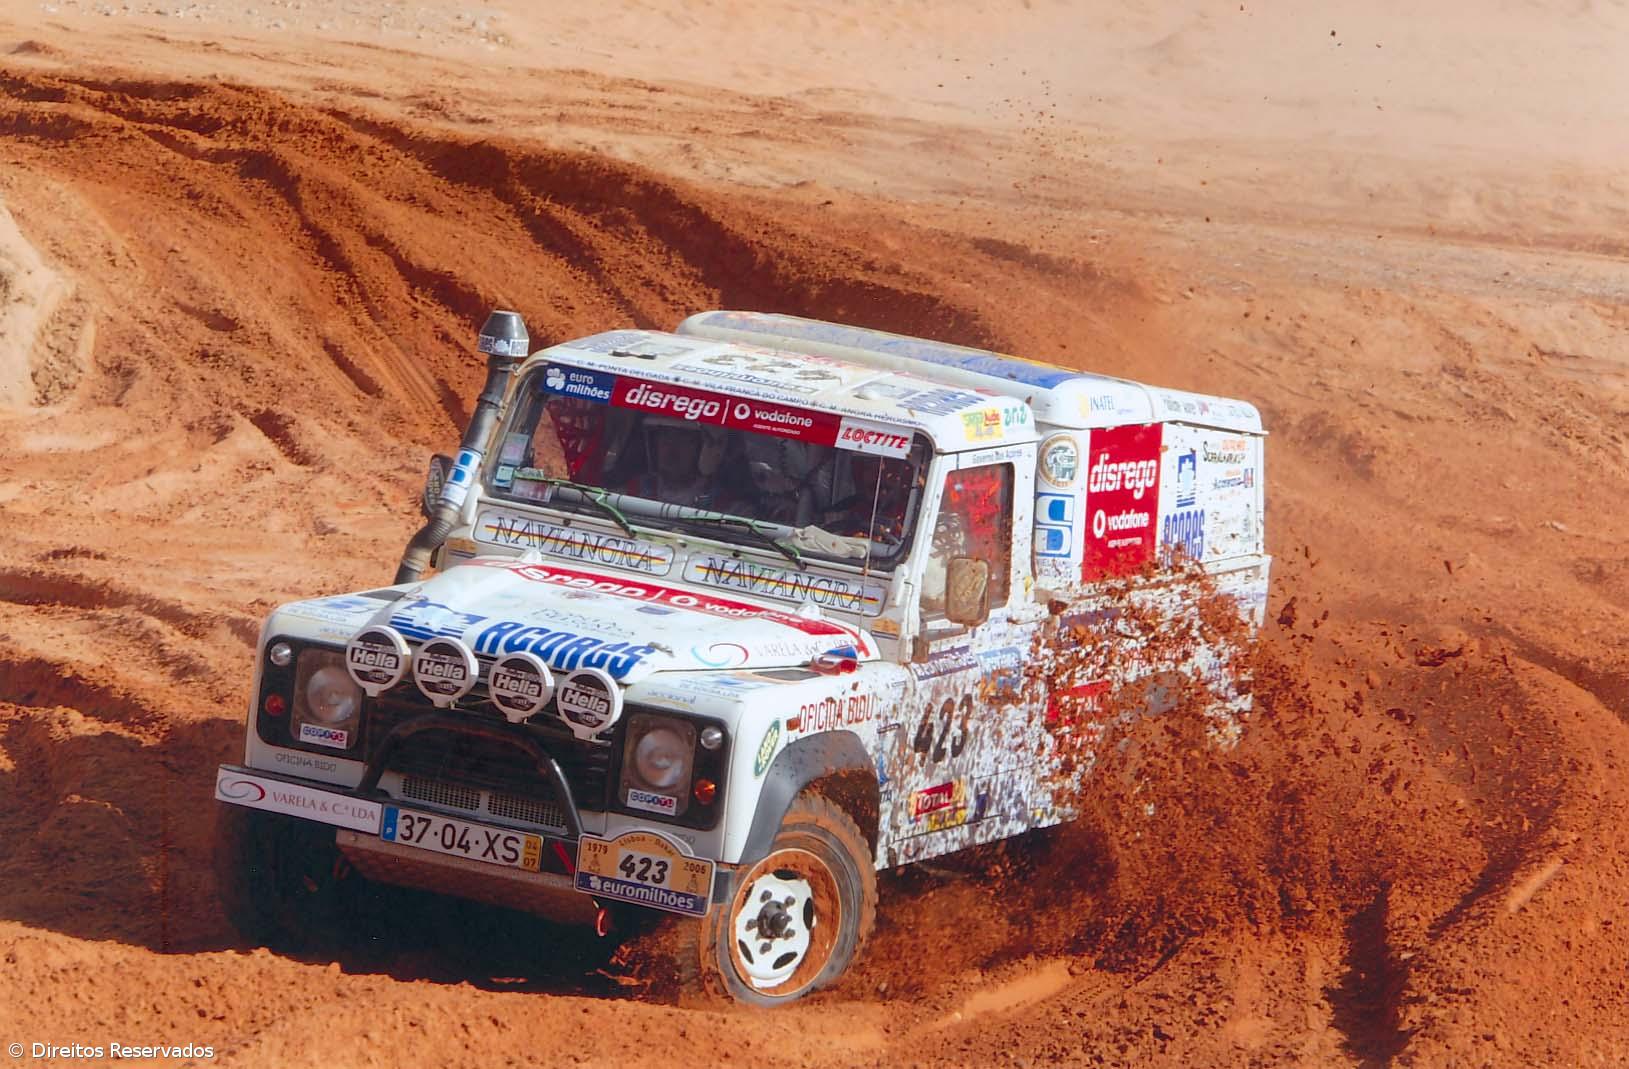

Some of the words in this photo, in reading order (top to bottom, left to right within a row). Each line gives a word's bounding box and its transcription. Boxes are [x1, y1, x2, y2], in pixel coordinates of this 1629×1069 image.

[569, 372, 594, 385] euro
[565, 383, 610, 399] milhões
[624, 383, 720, 420] disrego
[754, 409, 813, 429] vodafone
[840, 426, 910, 449] LOCTITE
[1088, 452, 1158, 500] disrego
[1106, 509, 1150, 532] vodafone
[352, 648, 397, 669] Hella
[419, 659, 464, 681] Hella
[495, 673, 540, 697] Hella
[564, 688, 609, 716] Hella
[913, 693, 974, 768] 423
[272, 791, 316, 810] VARELA
[319, 803, 328, 812] &
[351, 806, 376, 821] LDA
[917, 790, 951, 810] TOTAL
[523, 855, 537, 868] 07
[617, 853, 670, 885] 423
[602, 880, 695, 910] euromilhões
